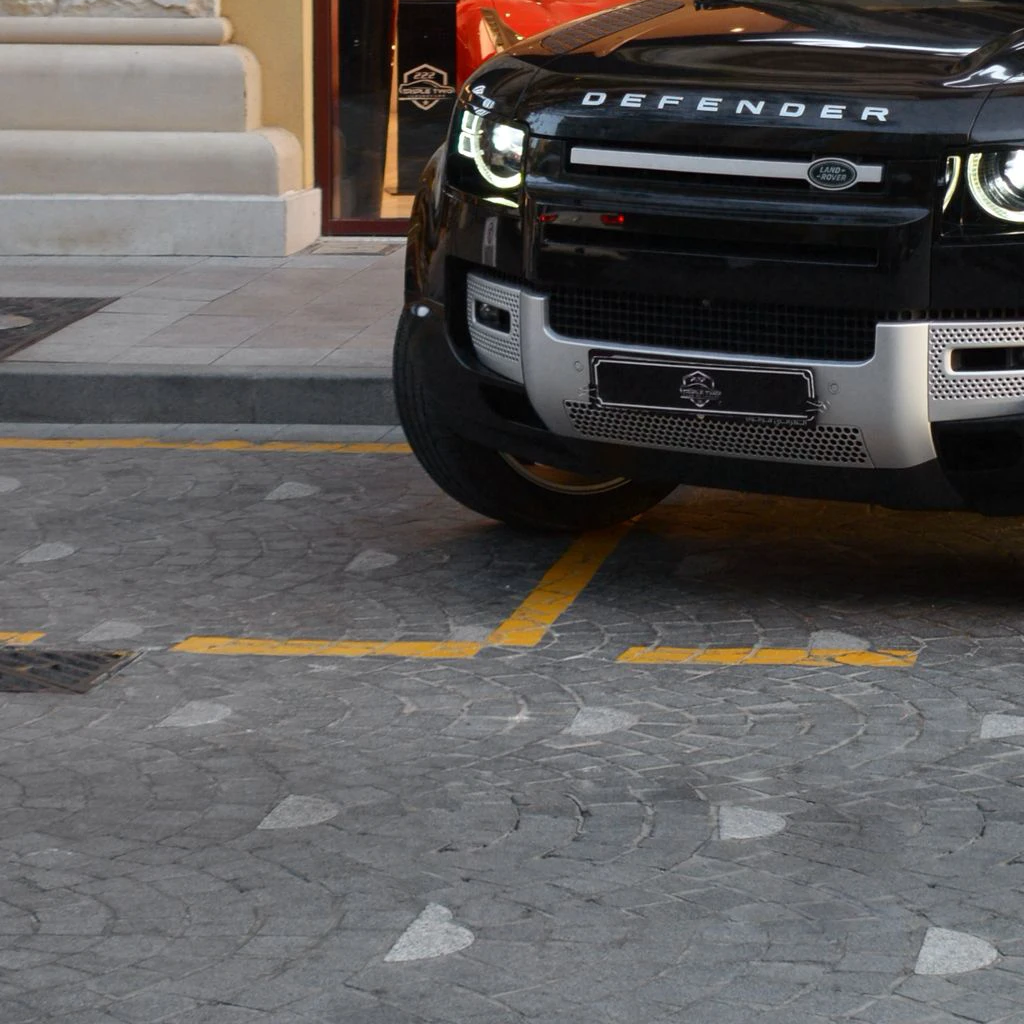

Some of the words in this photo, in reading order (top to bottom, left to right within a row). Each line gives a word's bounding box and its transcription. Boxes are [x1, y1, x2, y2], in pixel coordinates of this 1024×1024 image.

[582, 91, 889, 122] DEFENDER
[820, 166, 841, 174] LAND
[820, 173, 848, 182] ROVER
